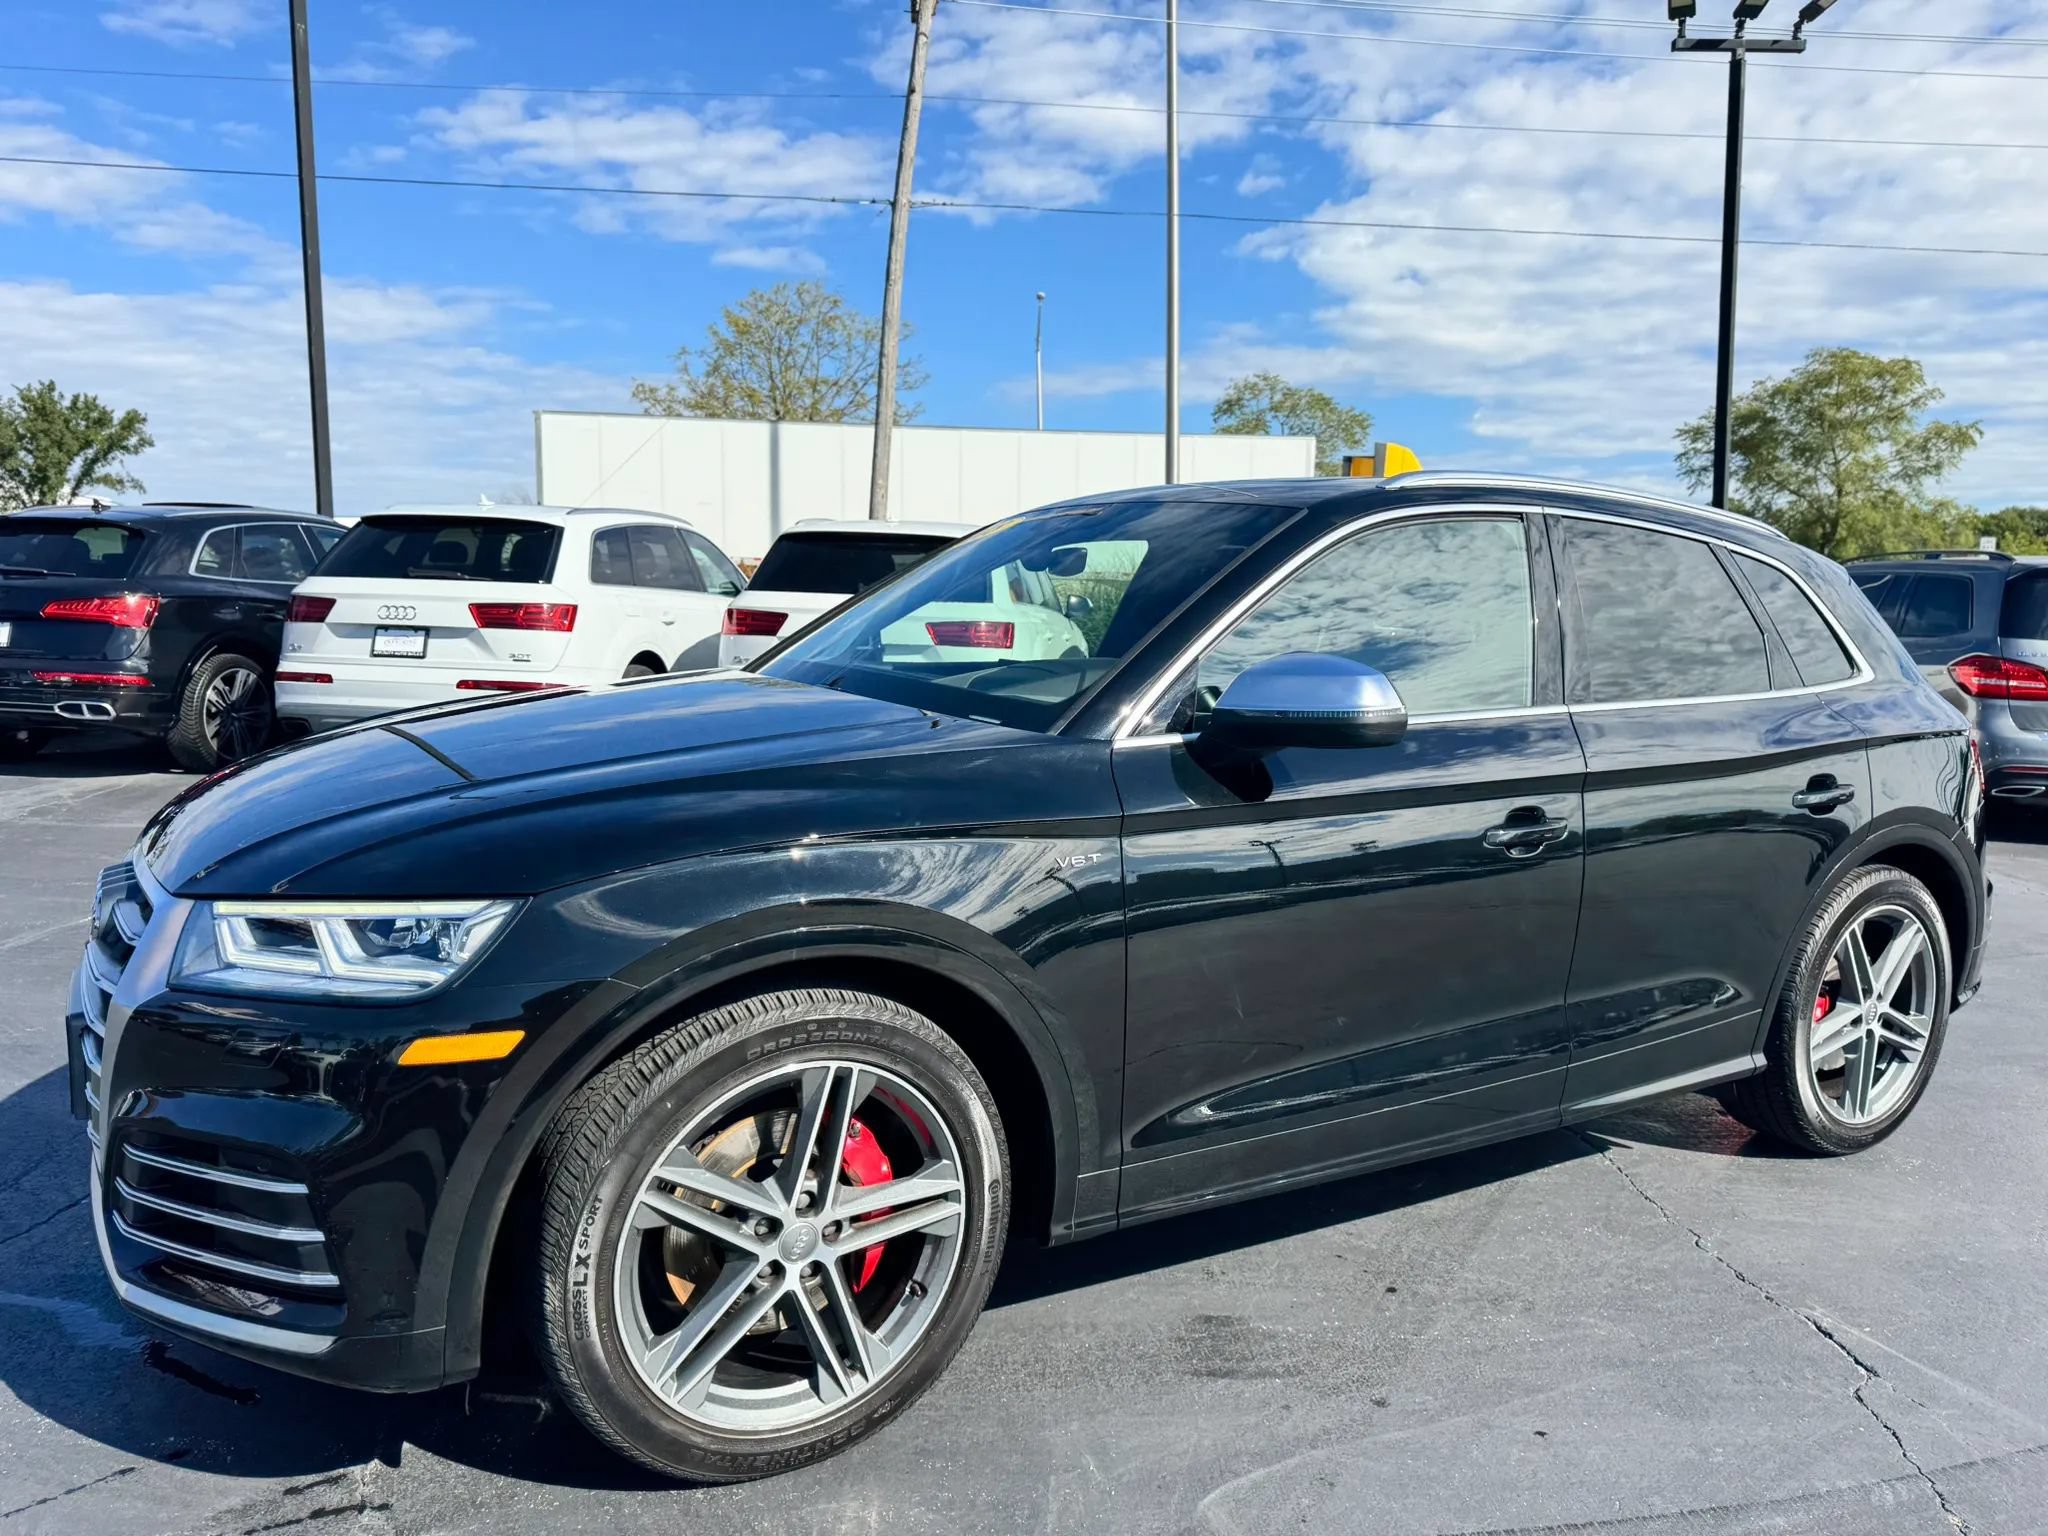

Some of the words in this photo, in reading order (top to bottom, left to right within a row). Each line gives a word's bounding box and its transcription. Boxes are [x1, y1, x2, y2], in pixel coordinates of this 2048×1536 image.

[1054, 853, 1102, 868] V6T
[578, 1194, 604, 1251] SPORT
[572, 1289, 585, 1341] CROSS
[582, 1289, 592, 1339] CONTACT
